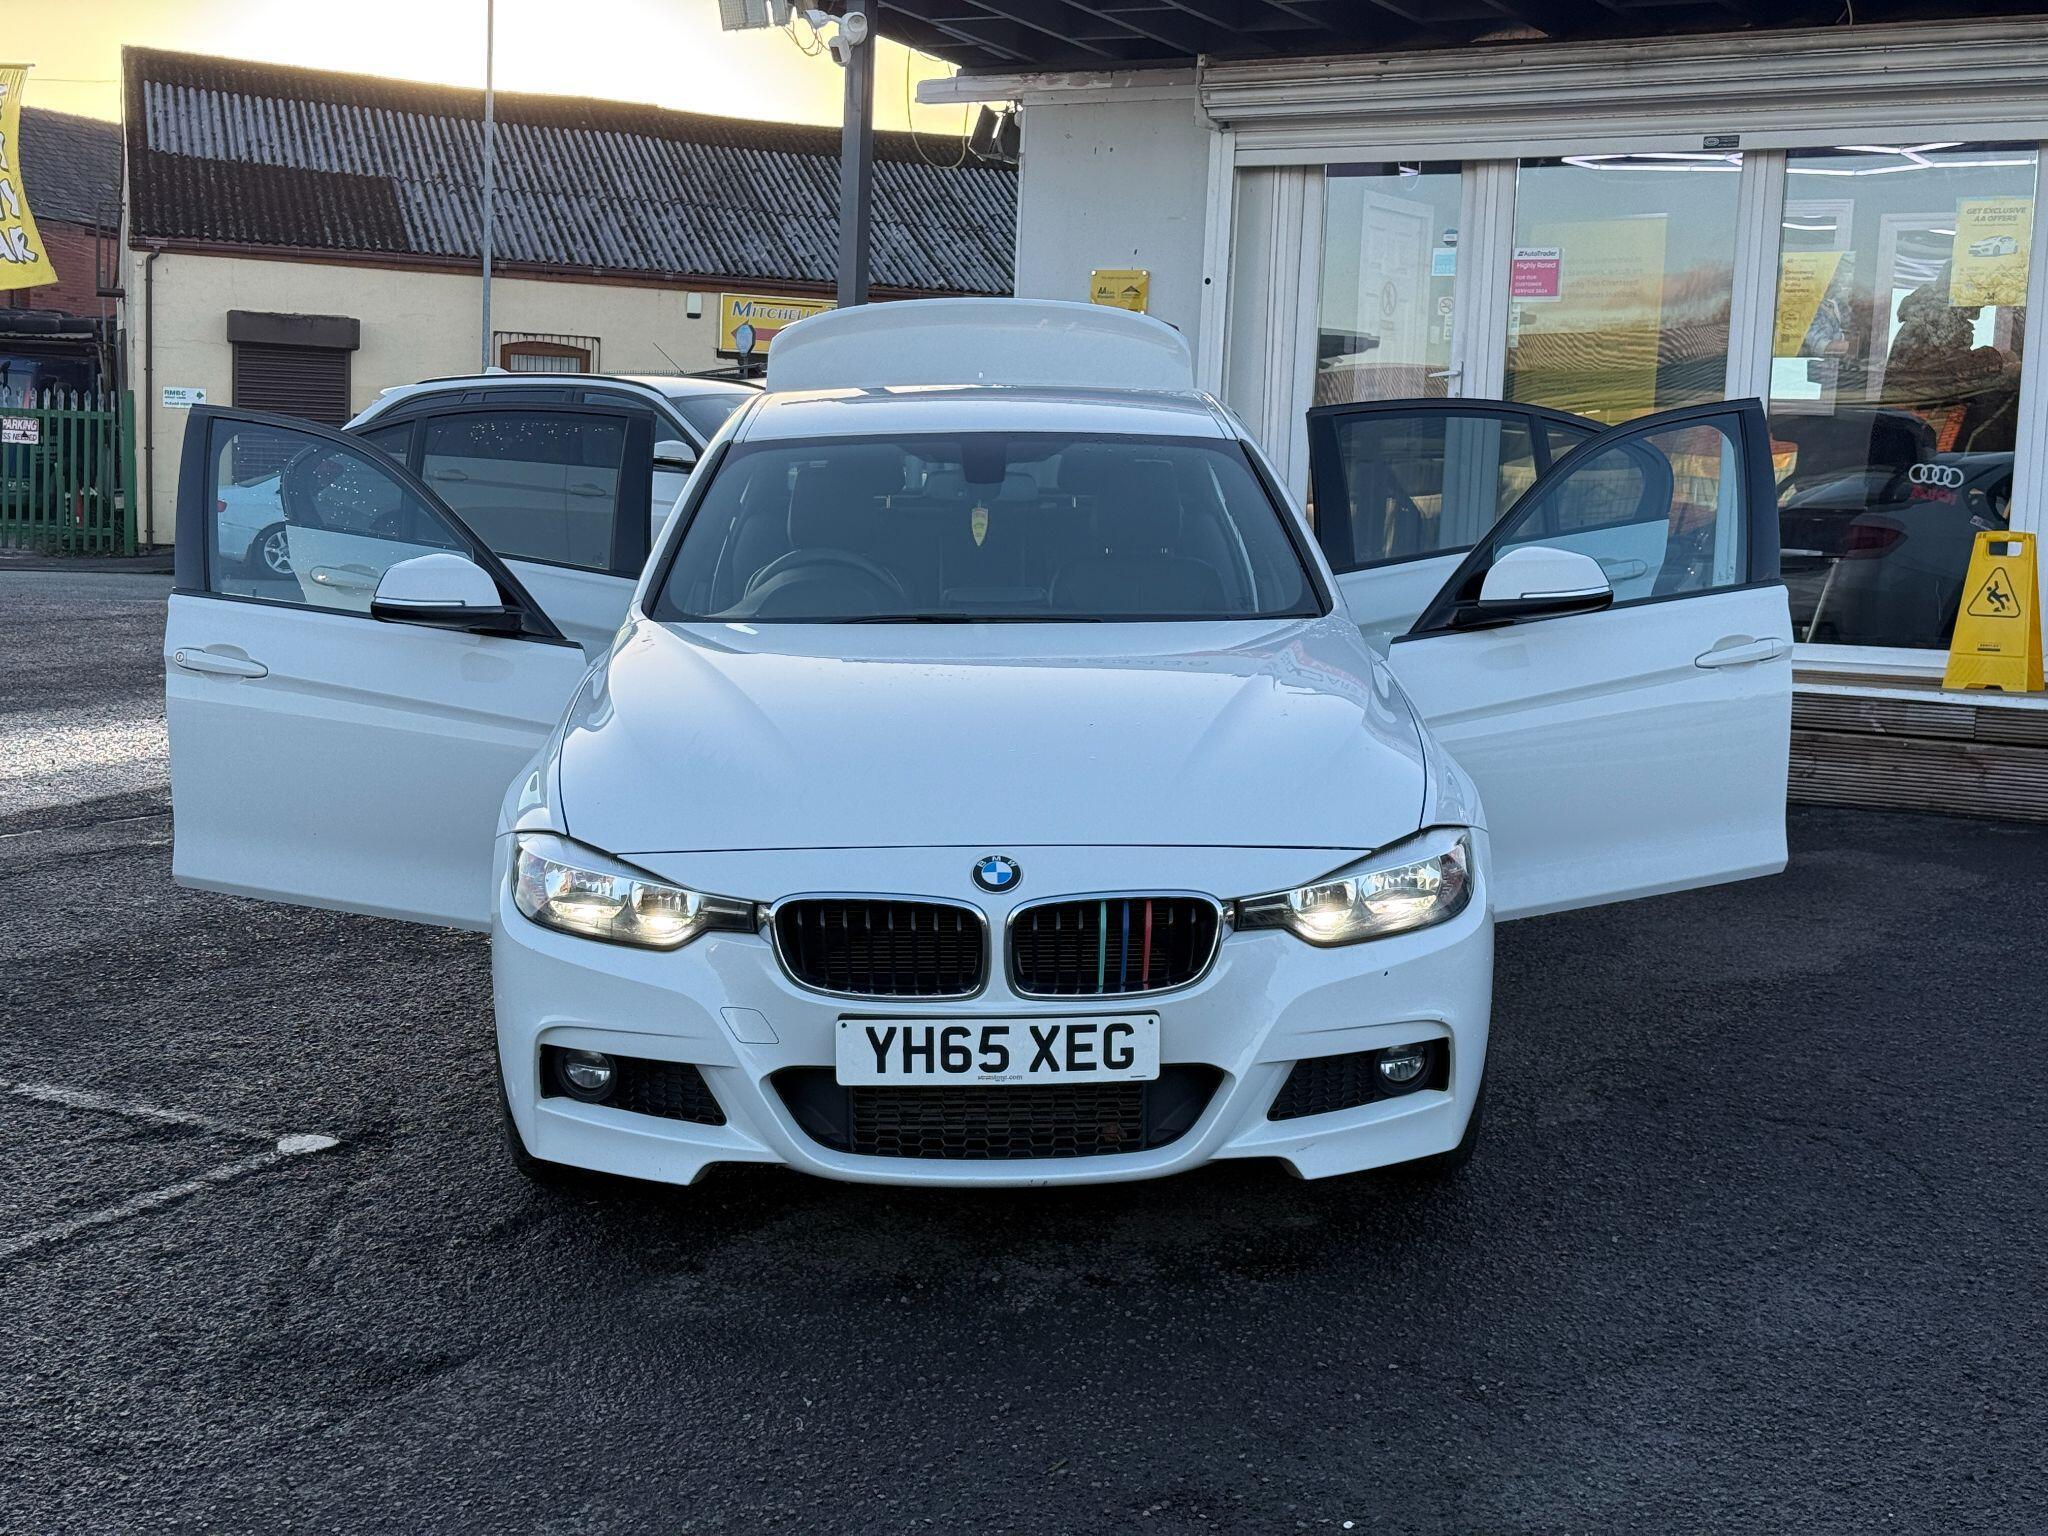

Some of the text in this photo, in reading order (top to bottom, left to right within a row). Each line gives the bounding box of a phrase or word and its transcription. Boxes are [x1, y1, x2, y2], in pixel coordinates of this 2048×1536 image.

[1517, 262, 1536, 270] Highly
[3, 418, 38, 431] PARKING
[976, 855, 1018, 868] BMW
[865, 1023, 1135, 1074] YH65 XEG
